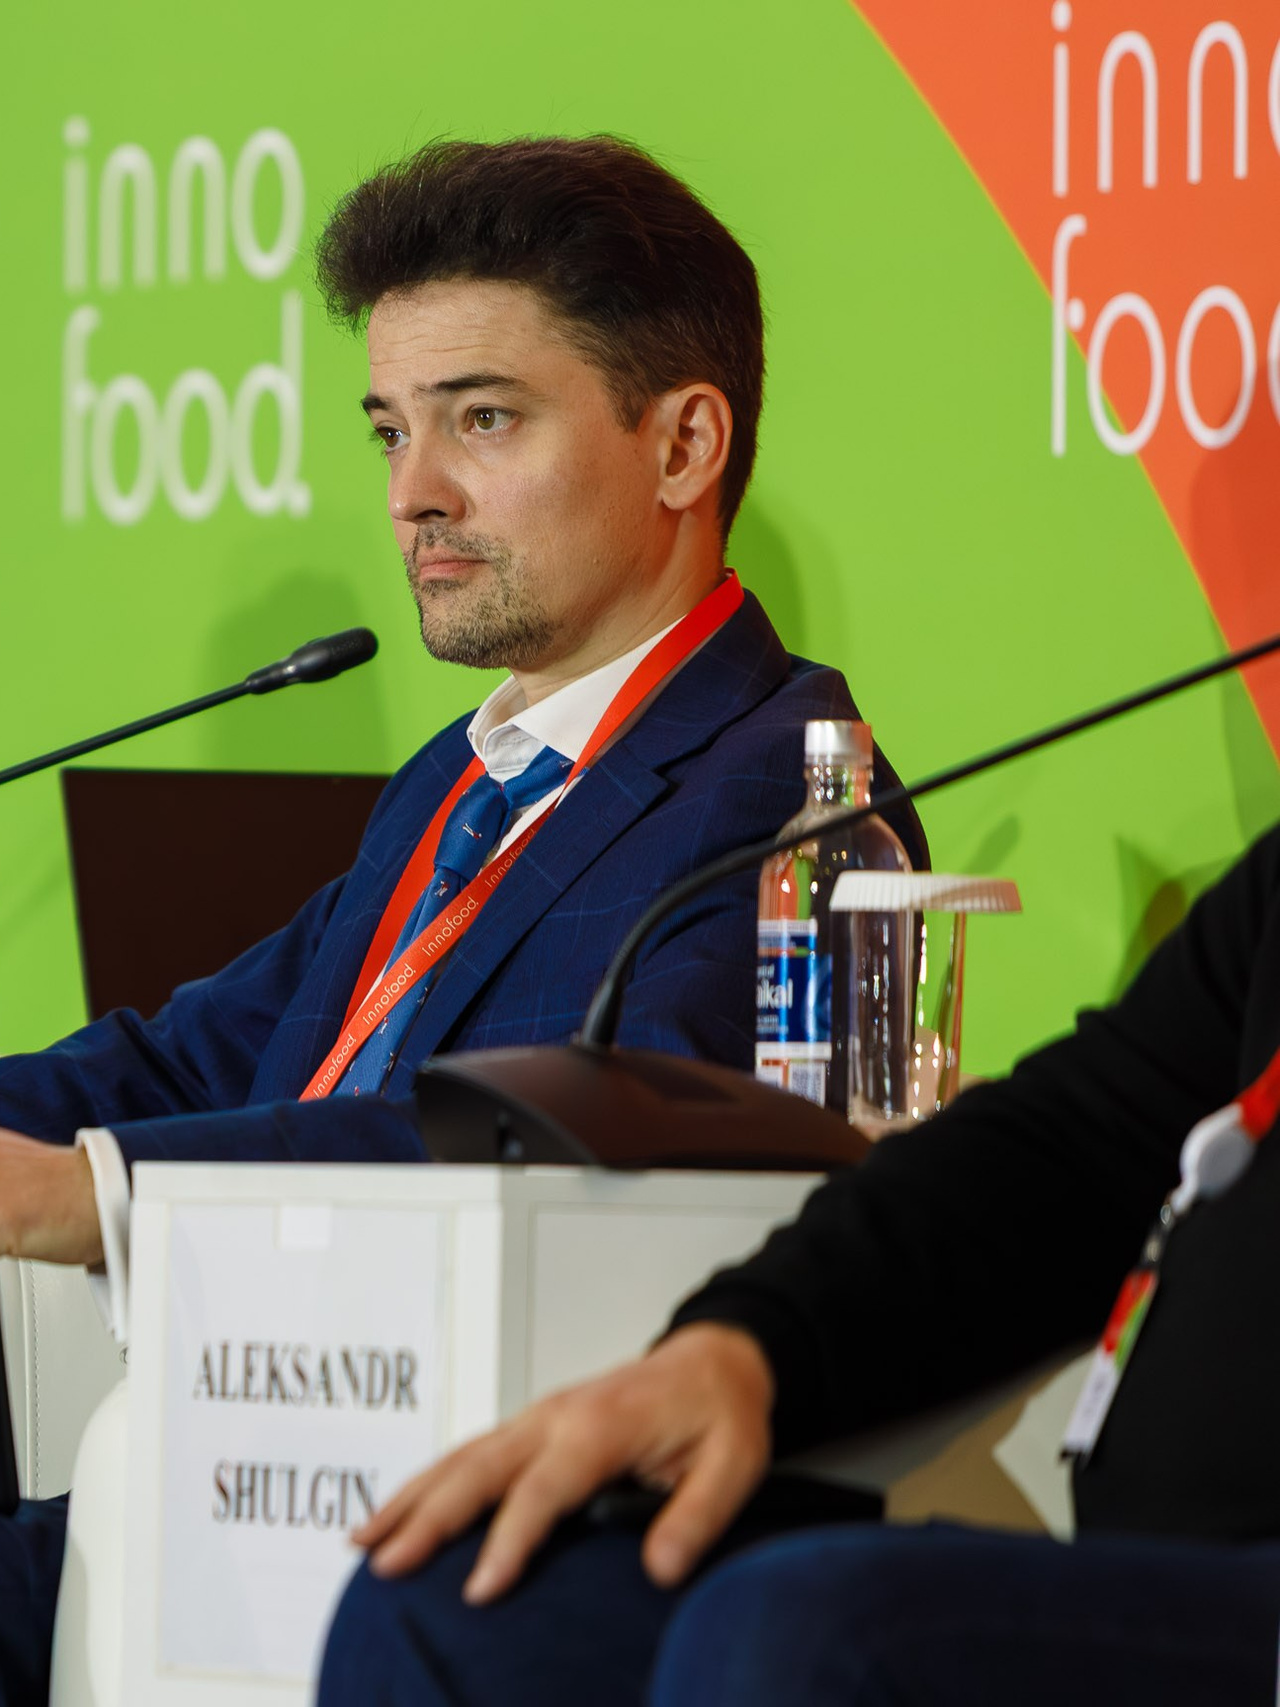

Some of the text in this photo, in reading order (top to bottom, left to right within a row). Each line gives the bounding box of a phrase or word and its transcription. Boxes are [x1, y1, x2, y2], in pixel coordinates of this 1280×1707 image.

[1051, 0, 1280, 197] inn
[62, 114, 305, 296] inno
[1051, 214, 1280, 457] foo
[194, 1340, 419, 1411] ALEKSANDR
